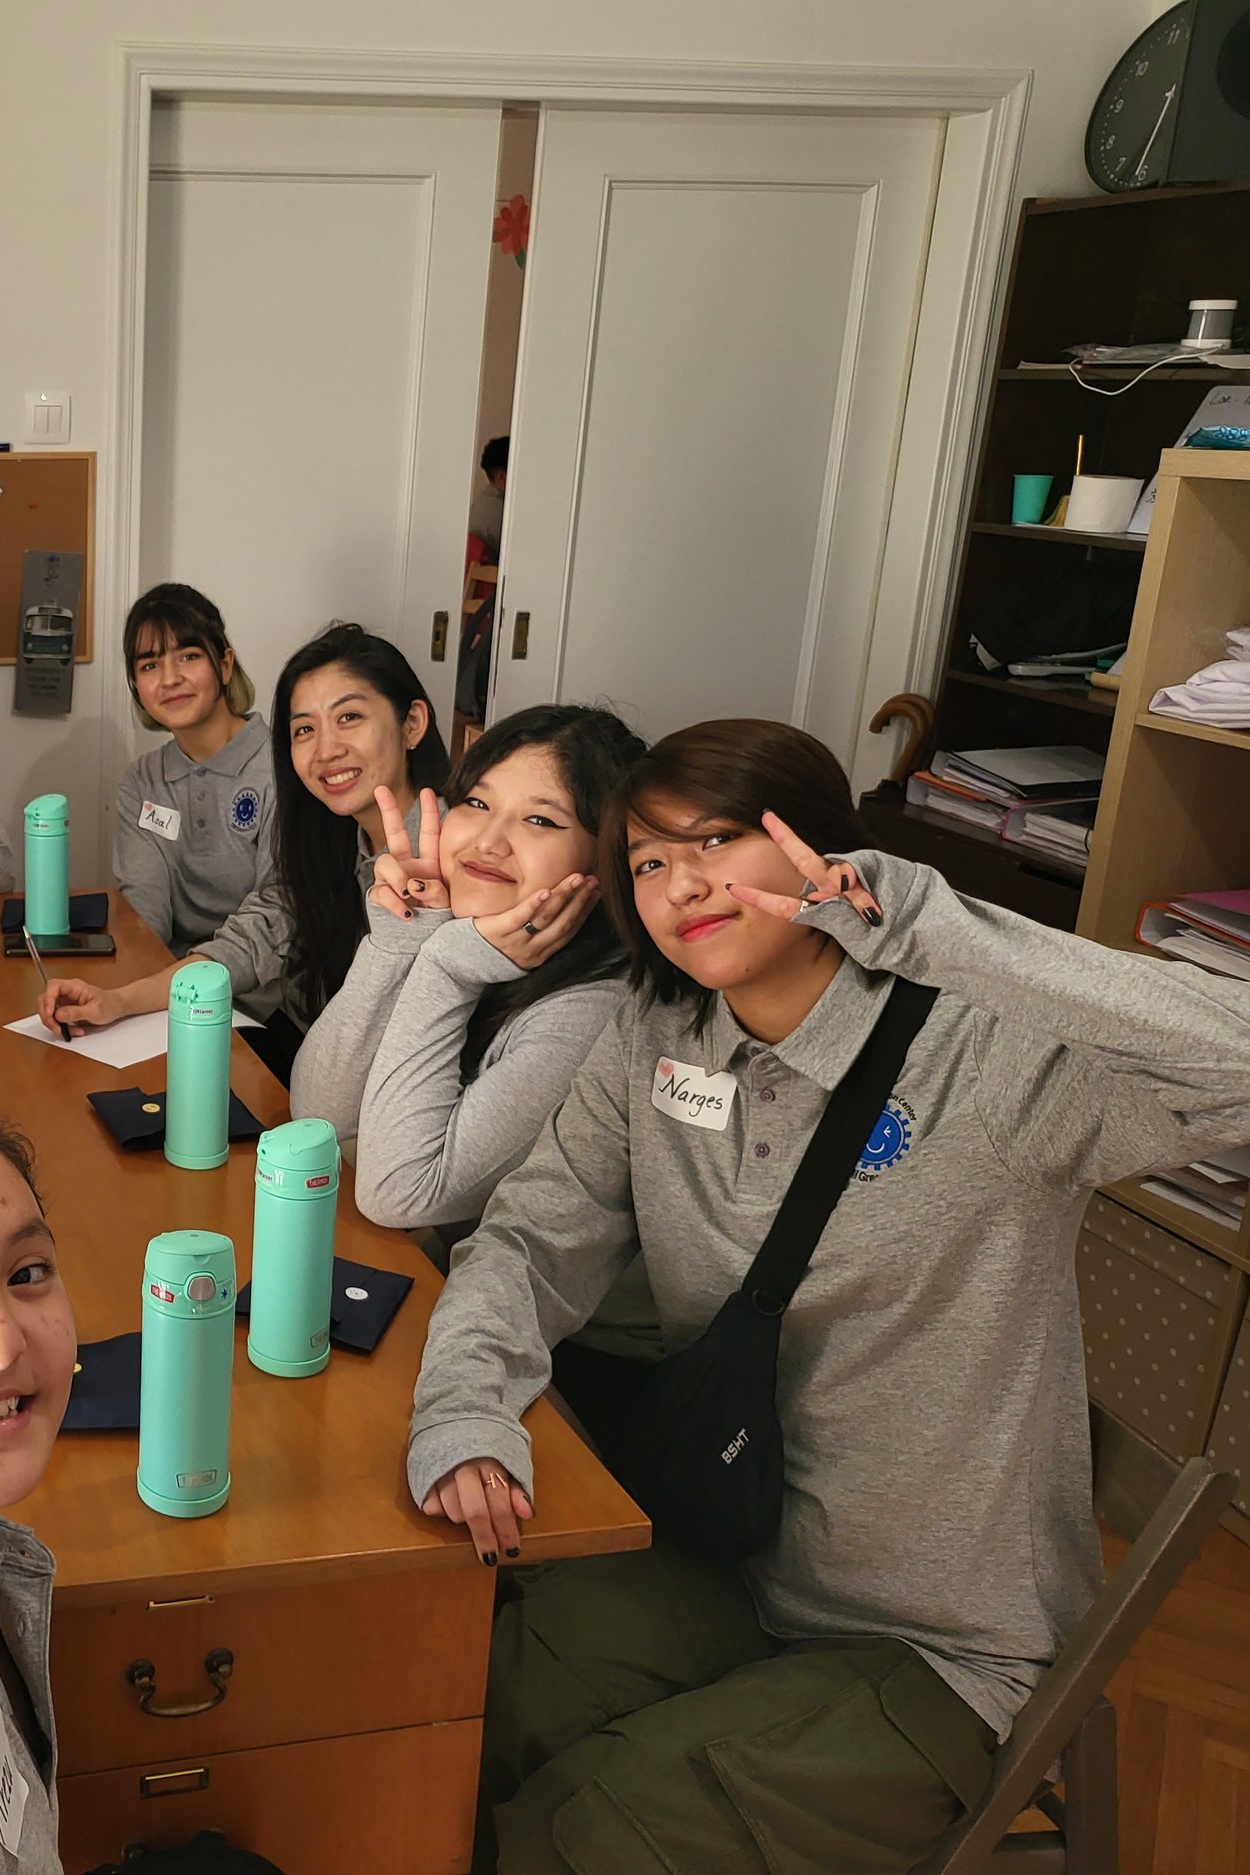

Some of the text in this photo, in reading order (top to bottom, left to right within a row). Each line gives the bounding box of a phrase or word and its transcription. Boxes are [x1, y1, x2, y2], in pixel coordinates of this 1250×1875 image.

[1167, 29, 1180, 45] 11
[1135, 60, 1149, 77] 10
[1114, 99, 1124, 113] 9
[1105, 134, 1116, 150] 8
[1115, 157, 1127, 172] 7
[1138, 164, 1149, 182] 6
[145, 809, 173, 830] Asal
[658, 1073, 723, 1117] Narges
[898, 1097, 917, 1121] Center
[721, 1428, 749, 1464] BSHT
